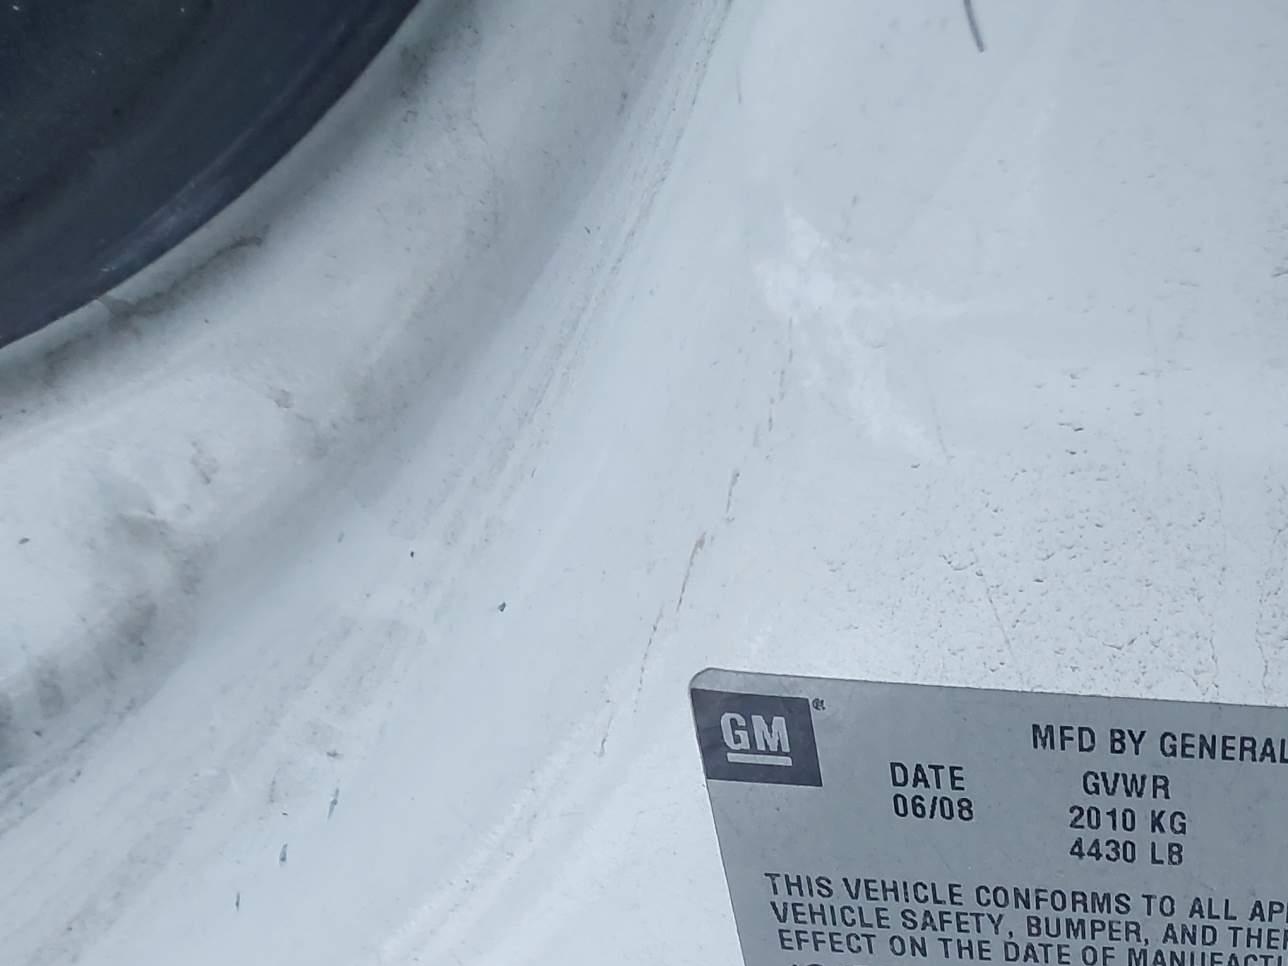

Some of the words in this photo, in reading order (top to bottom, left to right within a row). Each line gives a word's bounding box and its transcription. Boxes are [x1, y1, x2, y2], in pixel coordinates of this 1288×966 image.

[720, 712, 791, 753] GM
[1032, 723, 1097, 754] MFD
[1109, 730, 1146, 757] BY
[890, 761, 965, 791] DATE
[1083, 771, 1171, 800] GVWR
[893, 795, 975, 822] 06/08
[1069, 806, 1137, 834] 2010
[1150, 809, 1188, 836] KG
[1069, 838, 1137, 864] 4430
[1150, 841, 1184, 866] LB
[765, 872, 833, 898] THIS
[842, 877, 963, 907] VEHICLE
[975, 885, 1131, 916] CONFORMS
[1142, 893, 1176, 918] TO
[1188, 895, 1238, 922] ALL
[771, 901, 892, 930] VEHICLE
[901, 907, 1014, 939] SAFETY,
[1025, 916, 1150, 947] BUMPER,
[1161, 922, 1217, 948] AND
[778, 929, 876, 955] EFFECT
[888, 935, 928, 958] ON
[938, 937, 992, 961] THE
[1003, 940, 1070, 966] DATE
